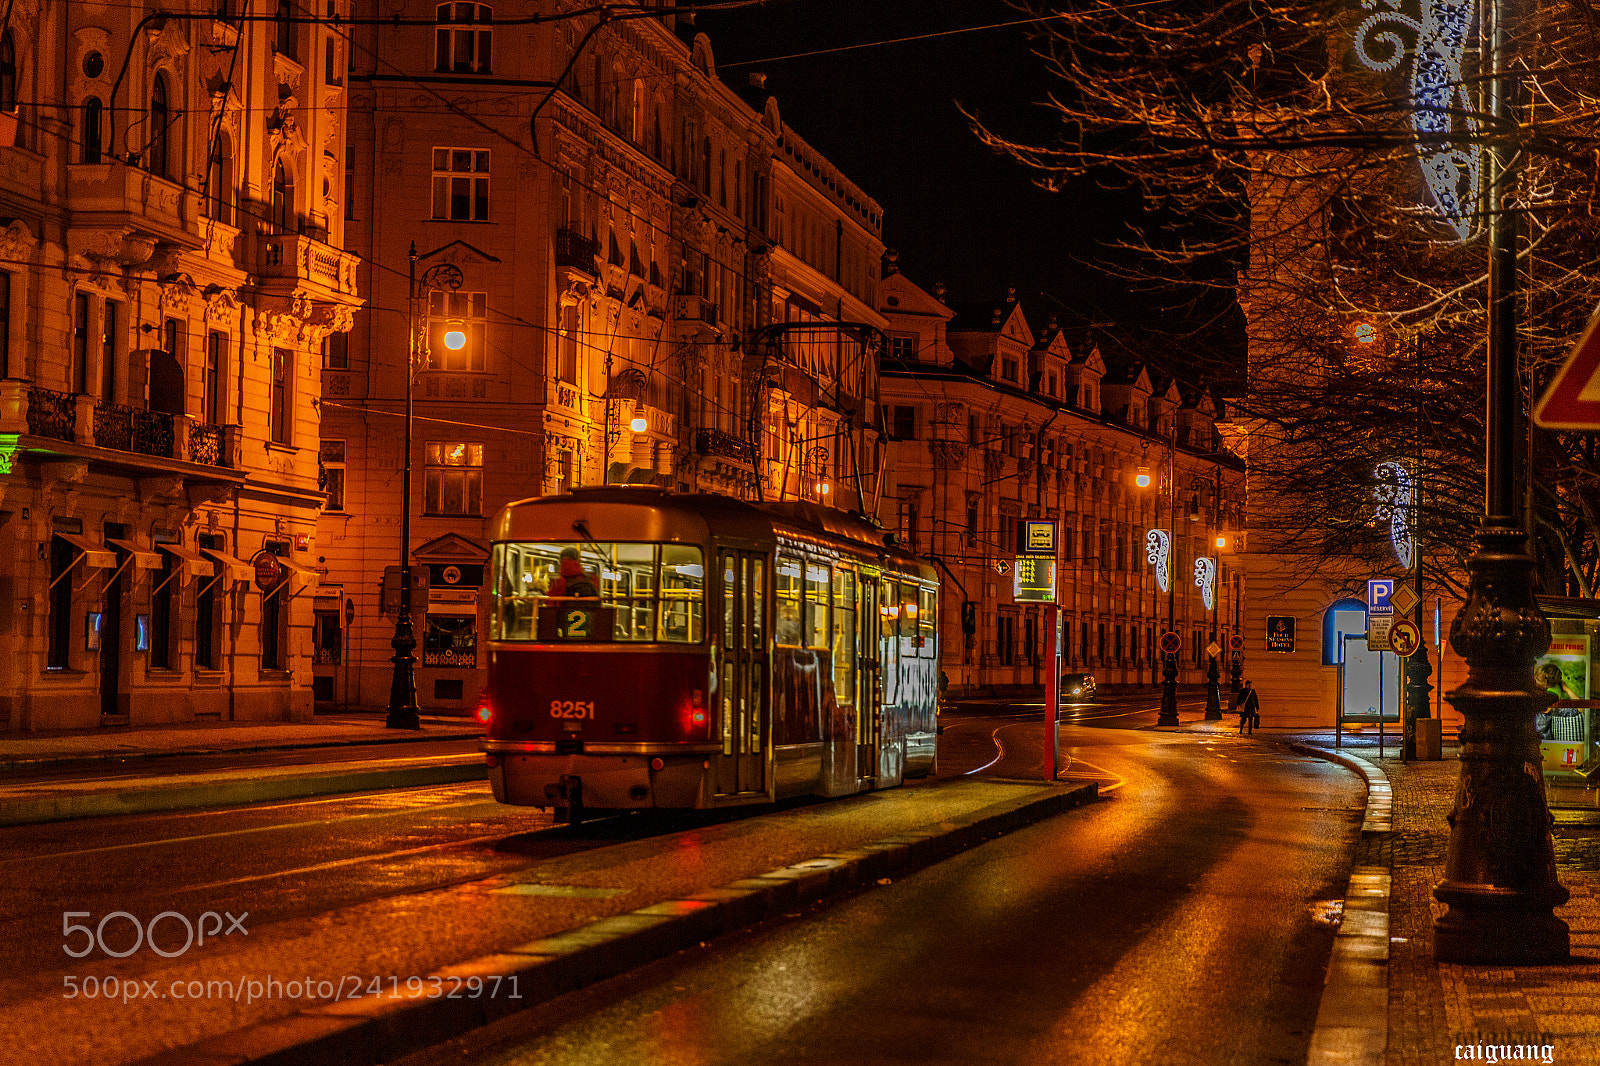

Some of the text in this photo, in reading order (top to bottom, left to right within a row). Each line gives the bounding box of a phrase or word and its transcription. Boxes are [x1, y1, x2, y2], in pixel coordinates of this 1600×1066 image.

[1373, 584, 1388, 604] P
[568, 610, 587, 636] 2
[550, 700, 595, 719] 8251
